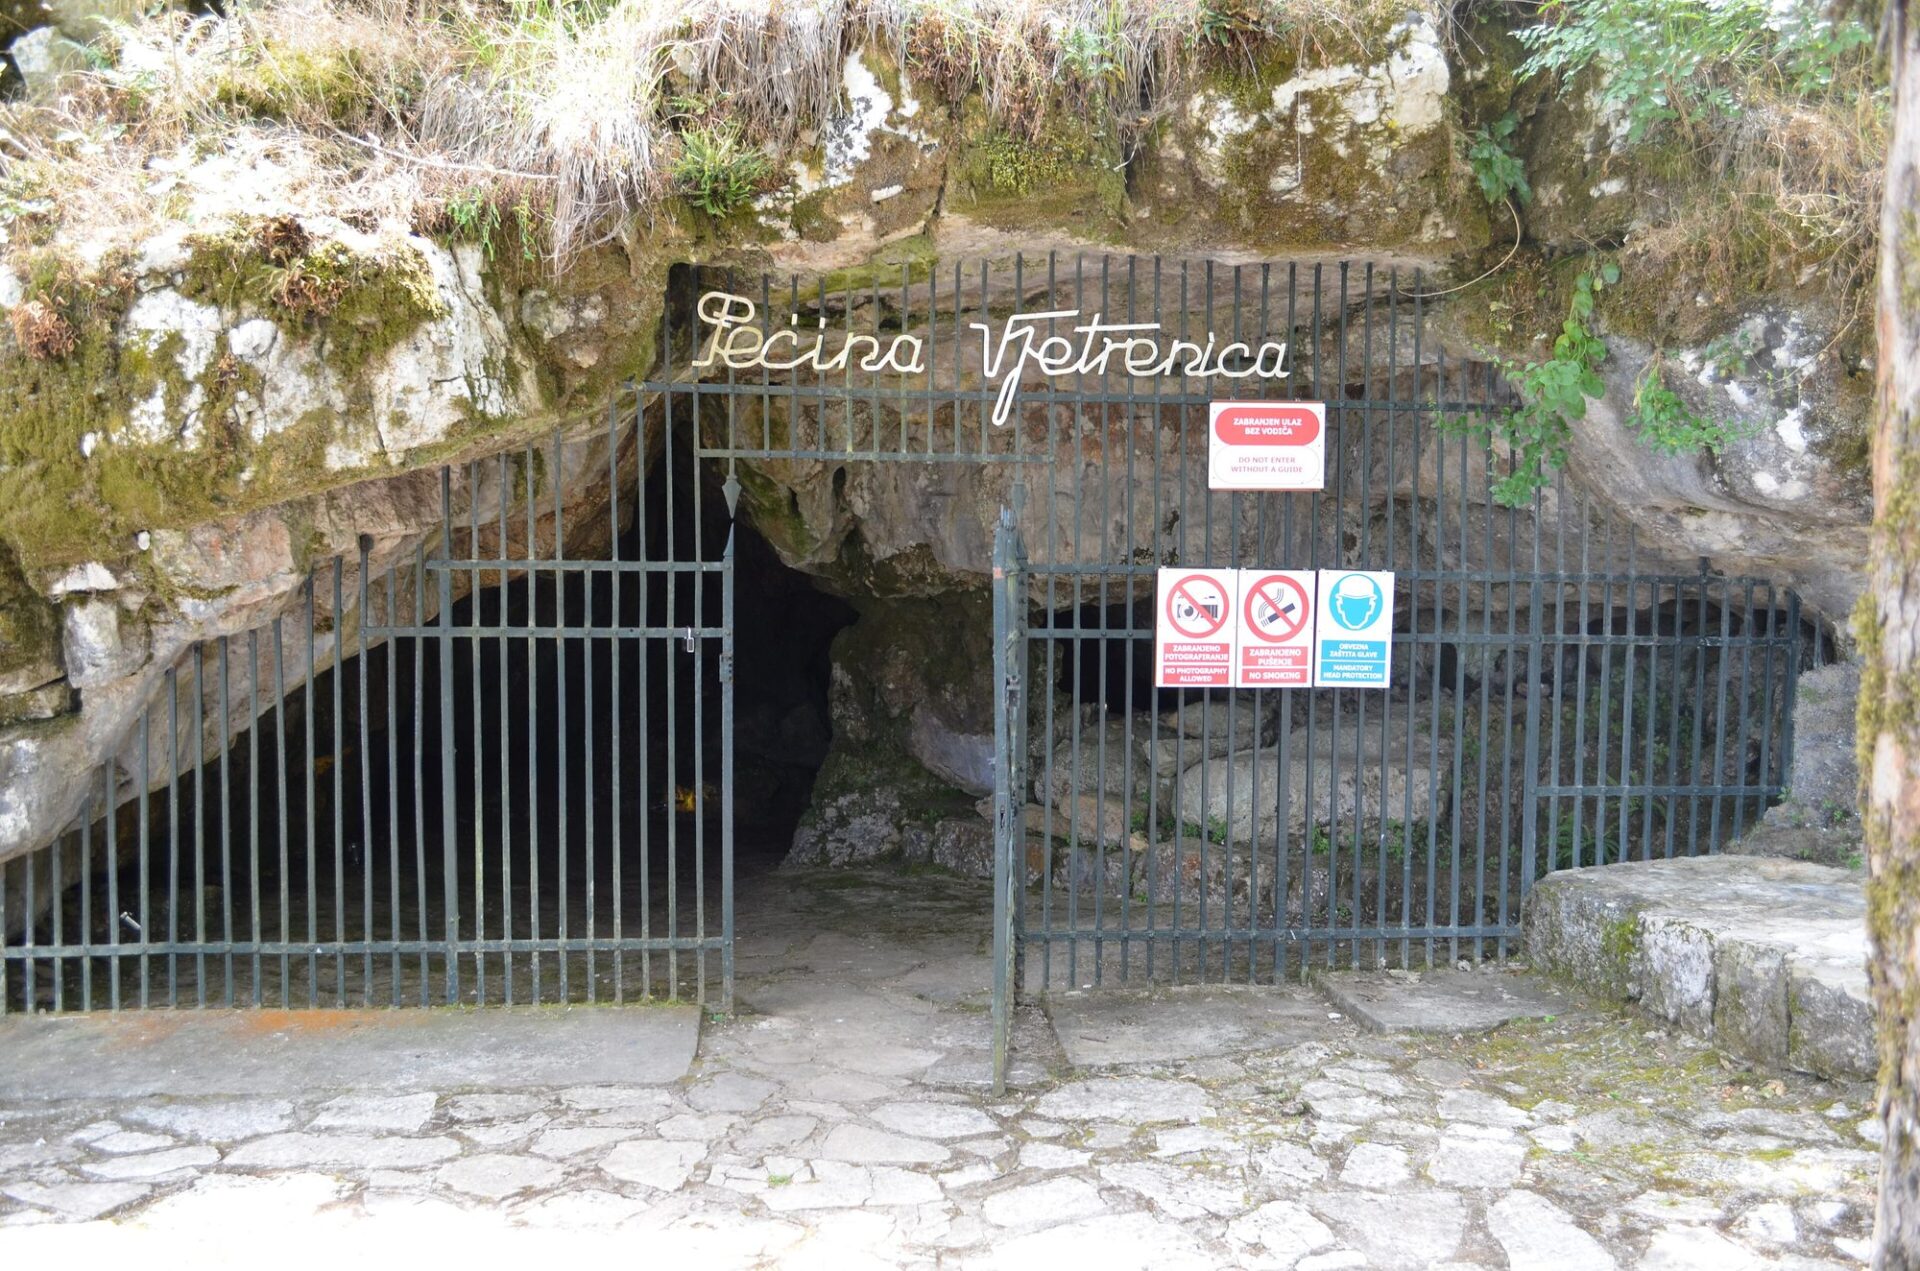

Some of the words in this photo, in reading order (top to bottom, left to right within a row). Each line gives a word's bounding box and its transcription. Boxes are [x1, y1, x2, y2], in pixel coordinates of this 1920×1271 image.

[969, 309, 1290, 426] Vjetrenica
[1233, 418, 1280, 426] ZABRANJEN
[1281, 418, 1302, 426] ULAZ
[1245, 427, 1260, 435] BEZ
[1261, 426, 1293, 435] VODIČA
[1238, 456, 1251, 464] DO
[1252, 456, 1269, 464] NOT
[1270, 456, 1296, 464] ENTER
[1231, 465, 1269, 473] WITHOUT
[1270, 465, 1277, 473] A
[1278, 465, 1303, 473] GUIDE
[1249, 648, 1302, 657] ZABRANJENO
[1329, 649, 1356, 657] ZAŠTITA
[1164, 653, 1229, 661] FOTOGRAFIRANJE
[1258, 656, 1293, 666] PUŠENJE
[1165, 667, 1176, 675] NO
[1176, 667, 1228, 675] PHOTOGRAPHY
[1323, 671, 1342, 679] HEAD
[1249, 671, 1261, 680] NO
[1262, 671, 1301, 680] SMOKING
